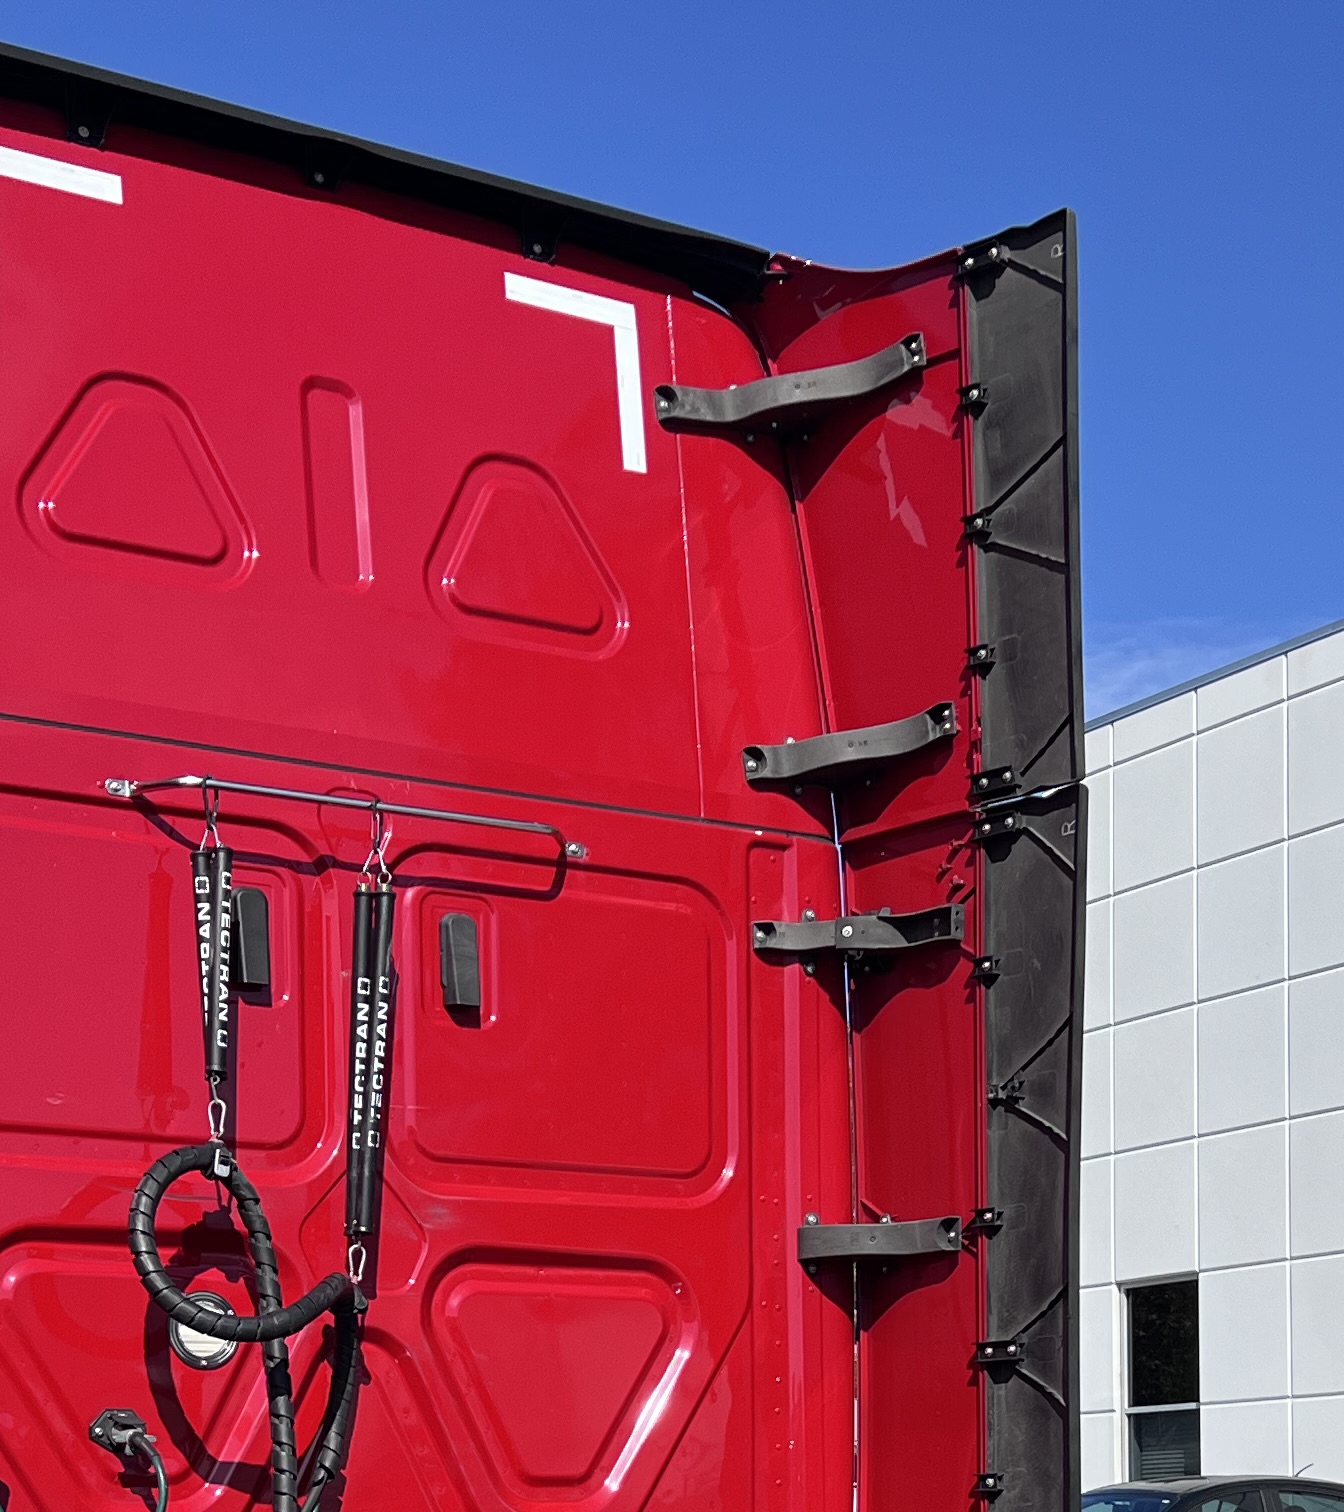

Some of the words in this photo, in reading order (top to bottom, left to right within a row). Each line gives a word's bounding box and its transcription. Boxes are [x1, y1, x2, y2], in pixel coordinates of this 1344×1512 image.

[218, 897, 232, 1022] TECTRAN
[353, 1002, 370, 1125] TECTRAN
[370, 1001, 389, 1123] TECTRAN
